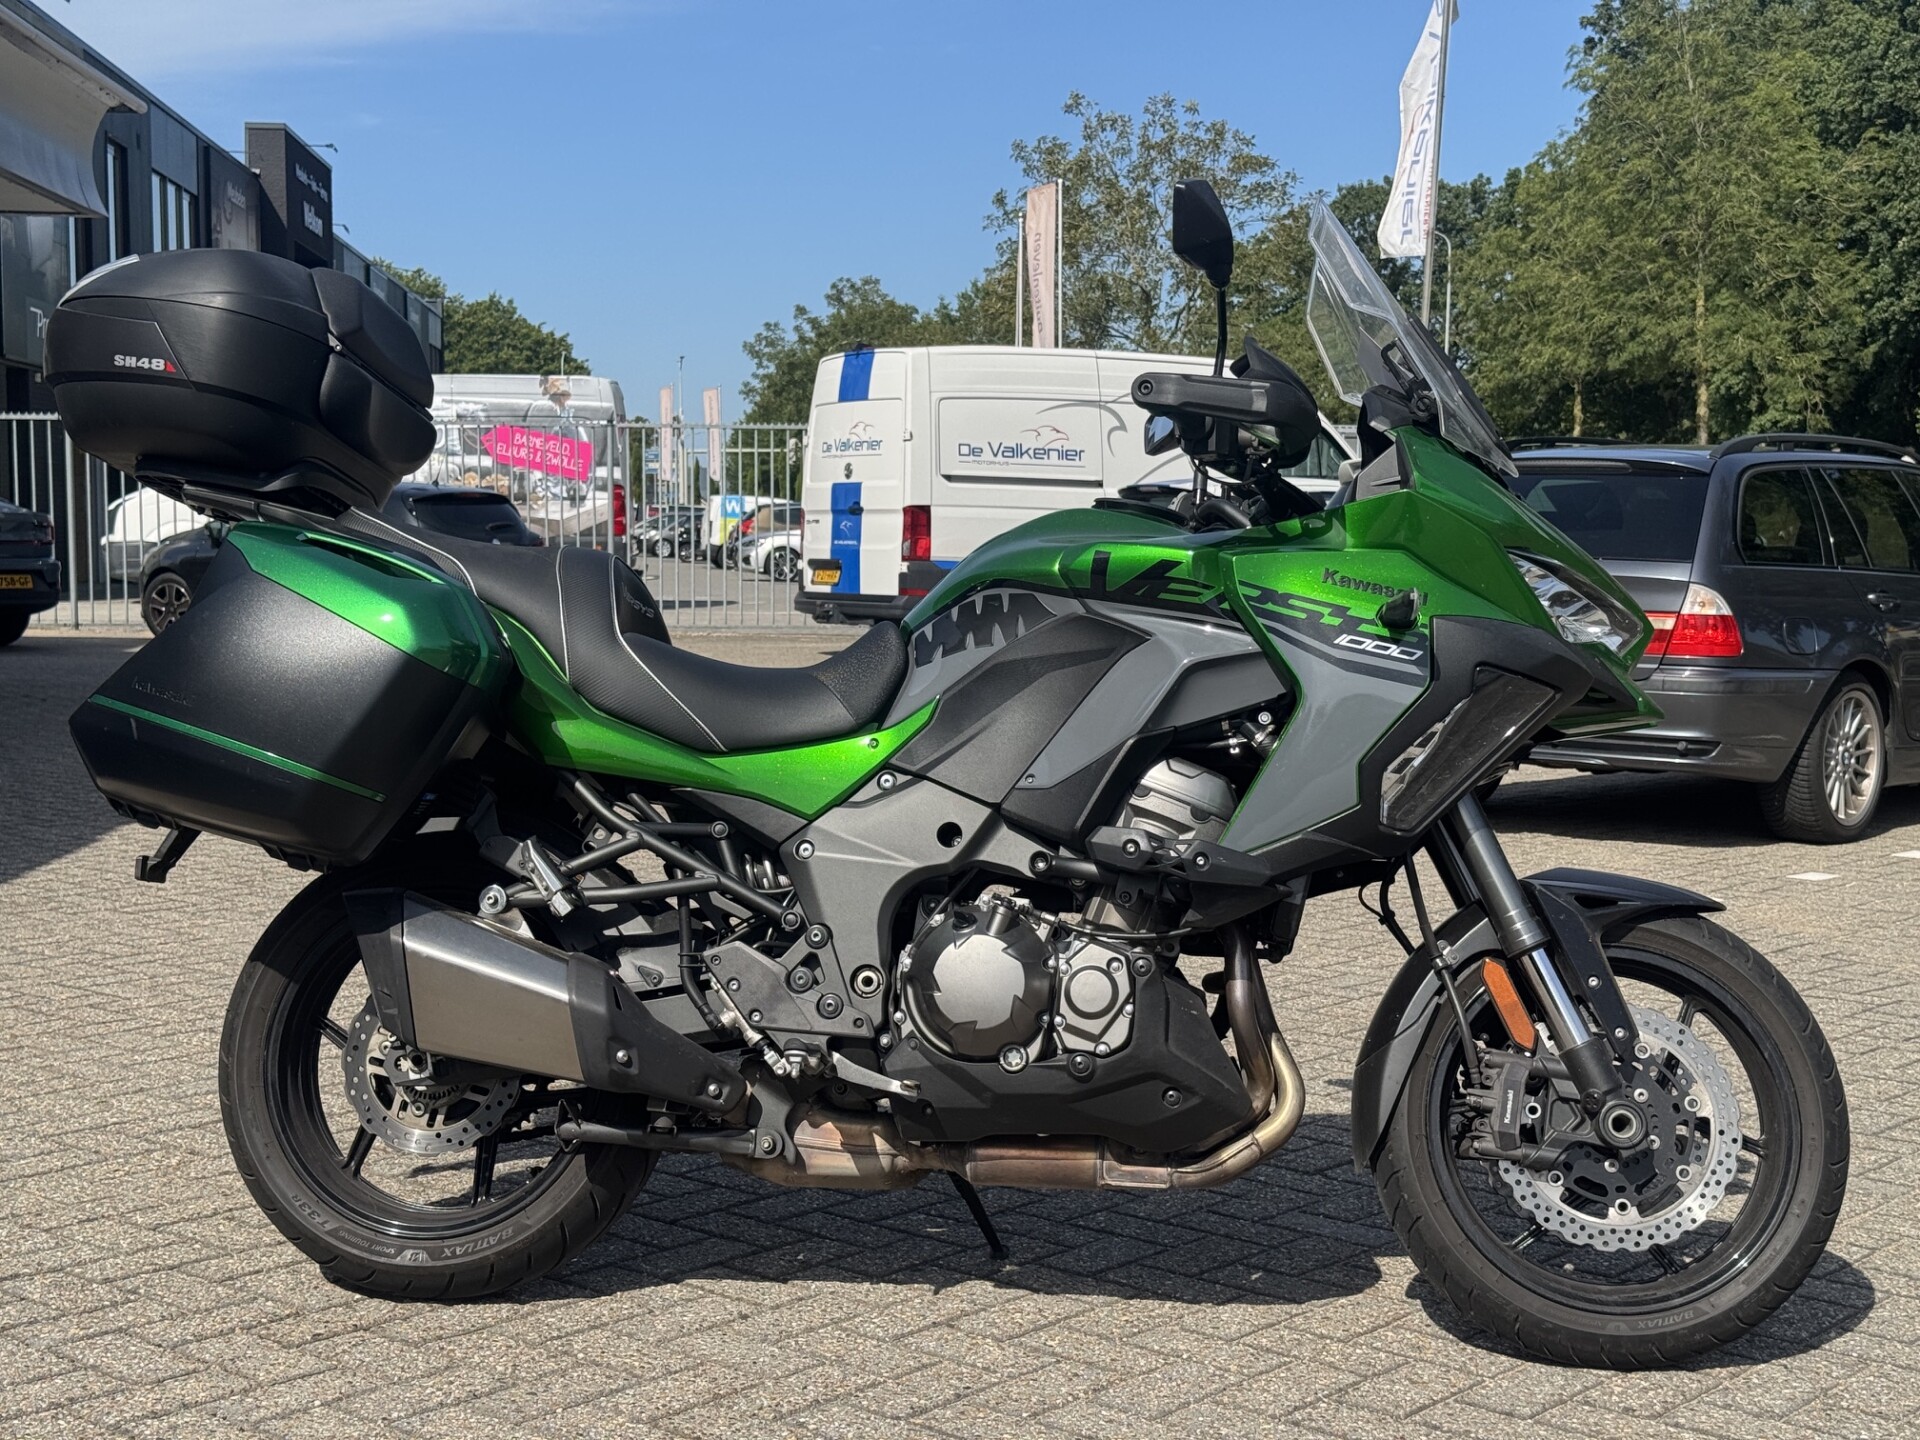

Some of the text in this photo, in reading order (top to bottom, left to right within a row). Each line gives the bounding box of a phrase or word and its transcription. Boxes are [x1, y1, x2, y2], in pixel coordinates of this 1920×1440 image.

[113, 354, 166, 371] SH48
[822, 437, 883, 453] De Valkenier
[958, 441, 1085, 462] De Valkenier
[1321, 567, 1429, 607] Kawasi
[1333, 633, 1424, 661] 1000
